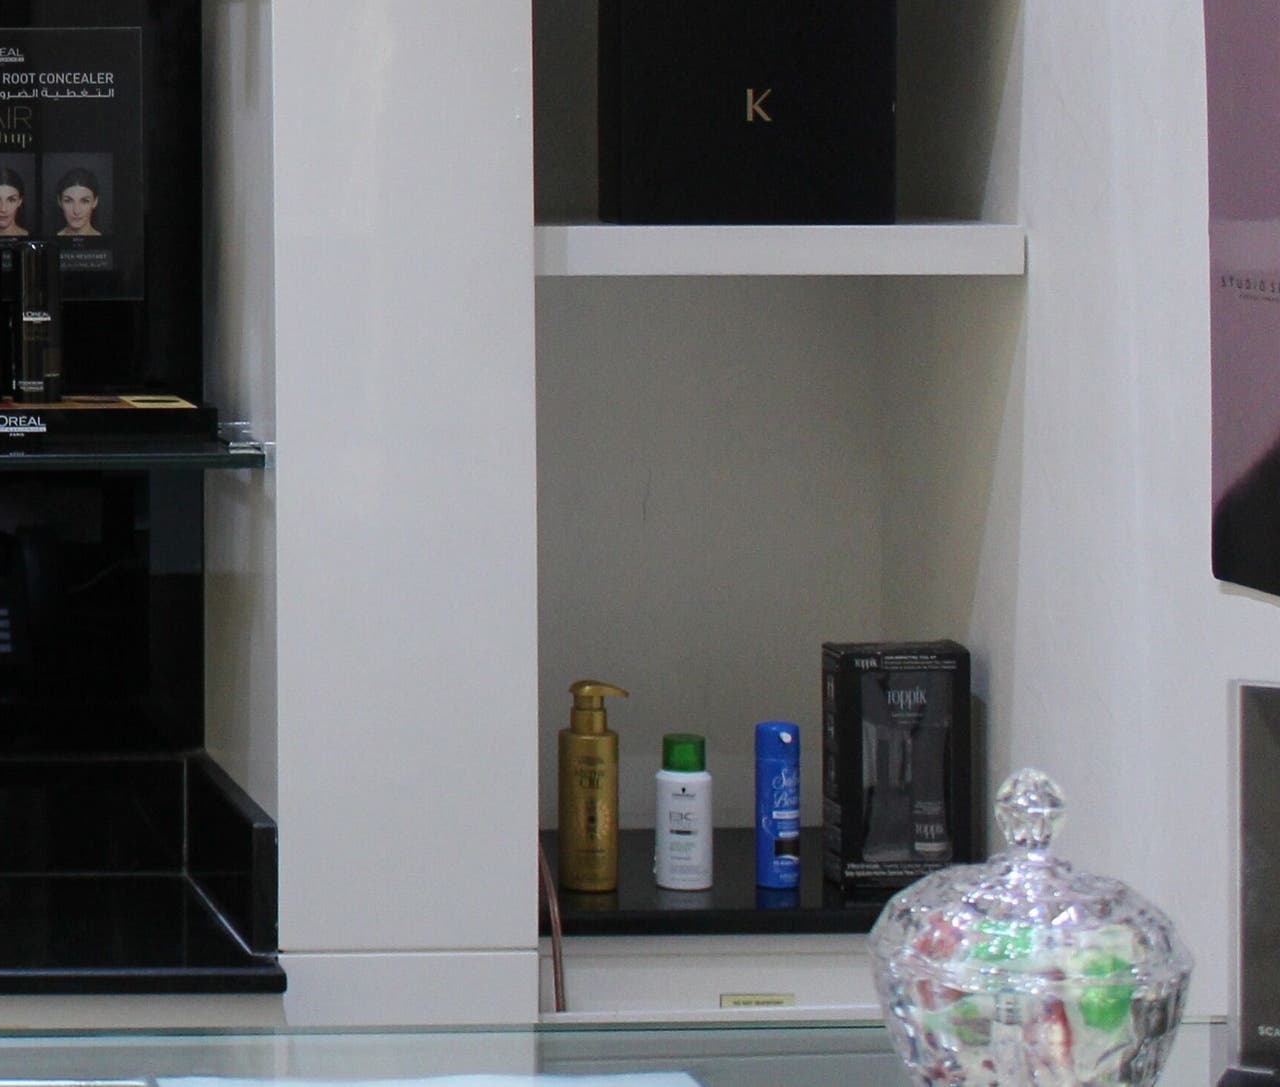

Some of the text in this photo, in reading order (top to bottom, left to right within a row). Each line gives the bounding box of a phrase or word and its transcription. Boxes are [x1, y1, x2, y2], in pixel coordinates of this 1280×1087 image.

[2, 72, 36, 84] ROOT
[39, 72, 114, 84] CONCEALER
[746, 89, 772, 122] K
